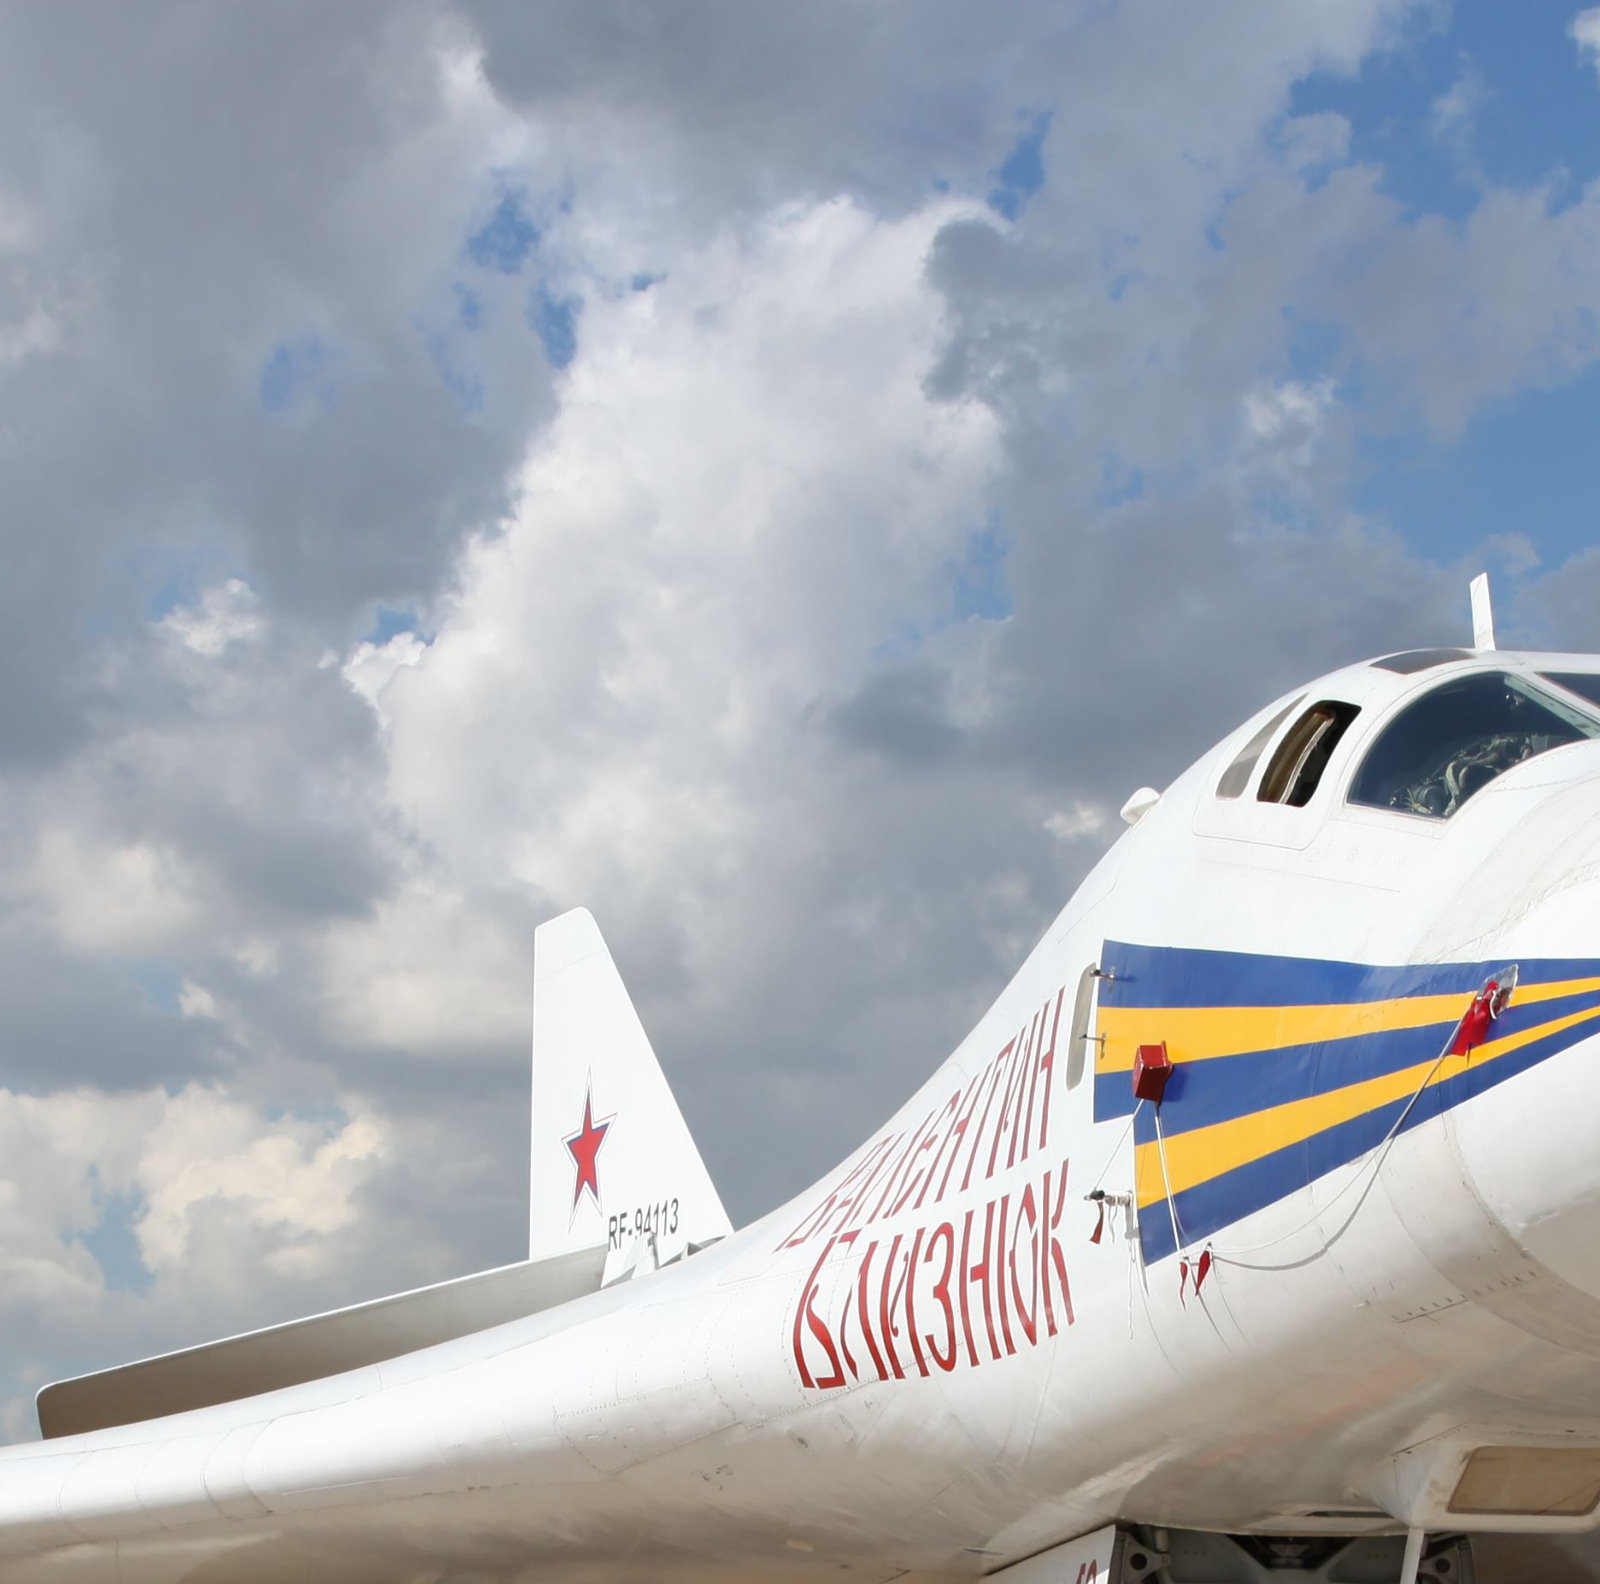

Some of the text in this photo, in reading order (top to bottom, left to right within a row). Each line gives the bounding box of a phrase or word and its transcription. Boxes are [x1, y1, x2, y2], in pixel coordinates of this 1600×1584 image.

[608, 1198, 679, 1252] RF-94113
[773, 985, 1066, 1253] ВАЛЕНТИН
[793, 1158, 1075, 1389] БЛИЗНЮК
